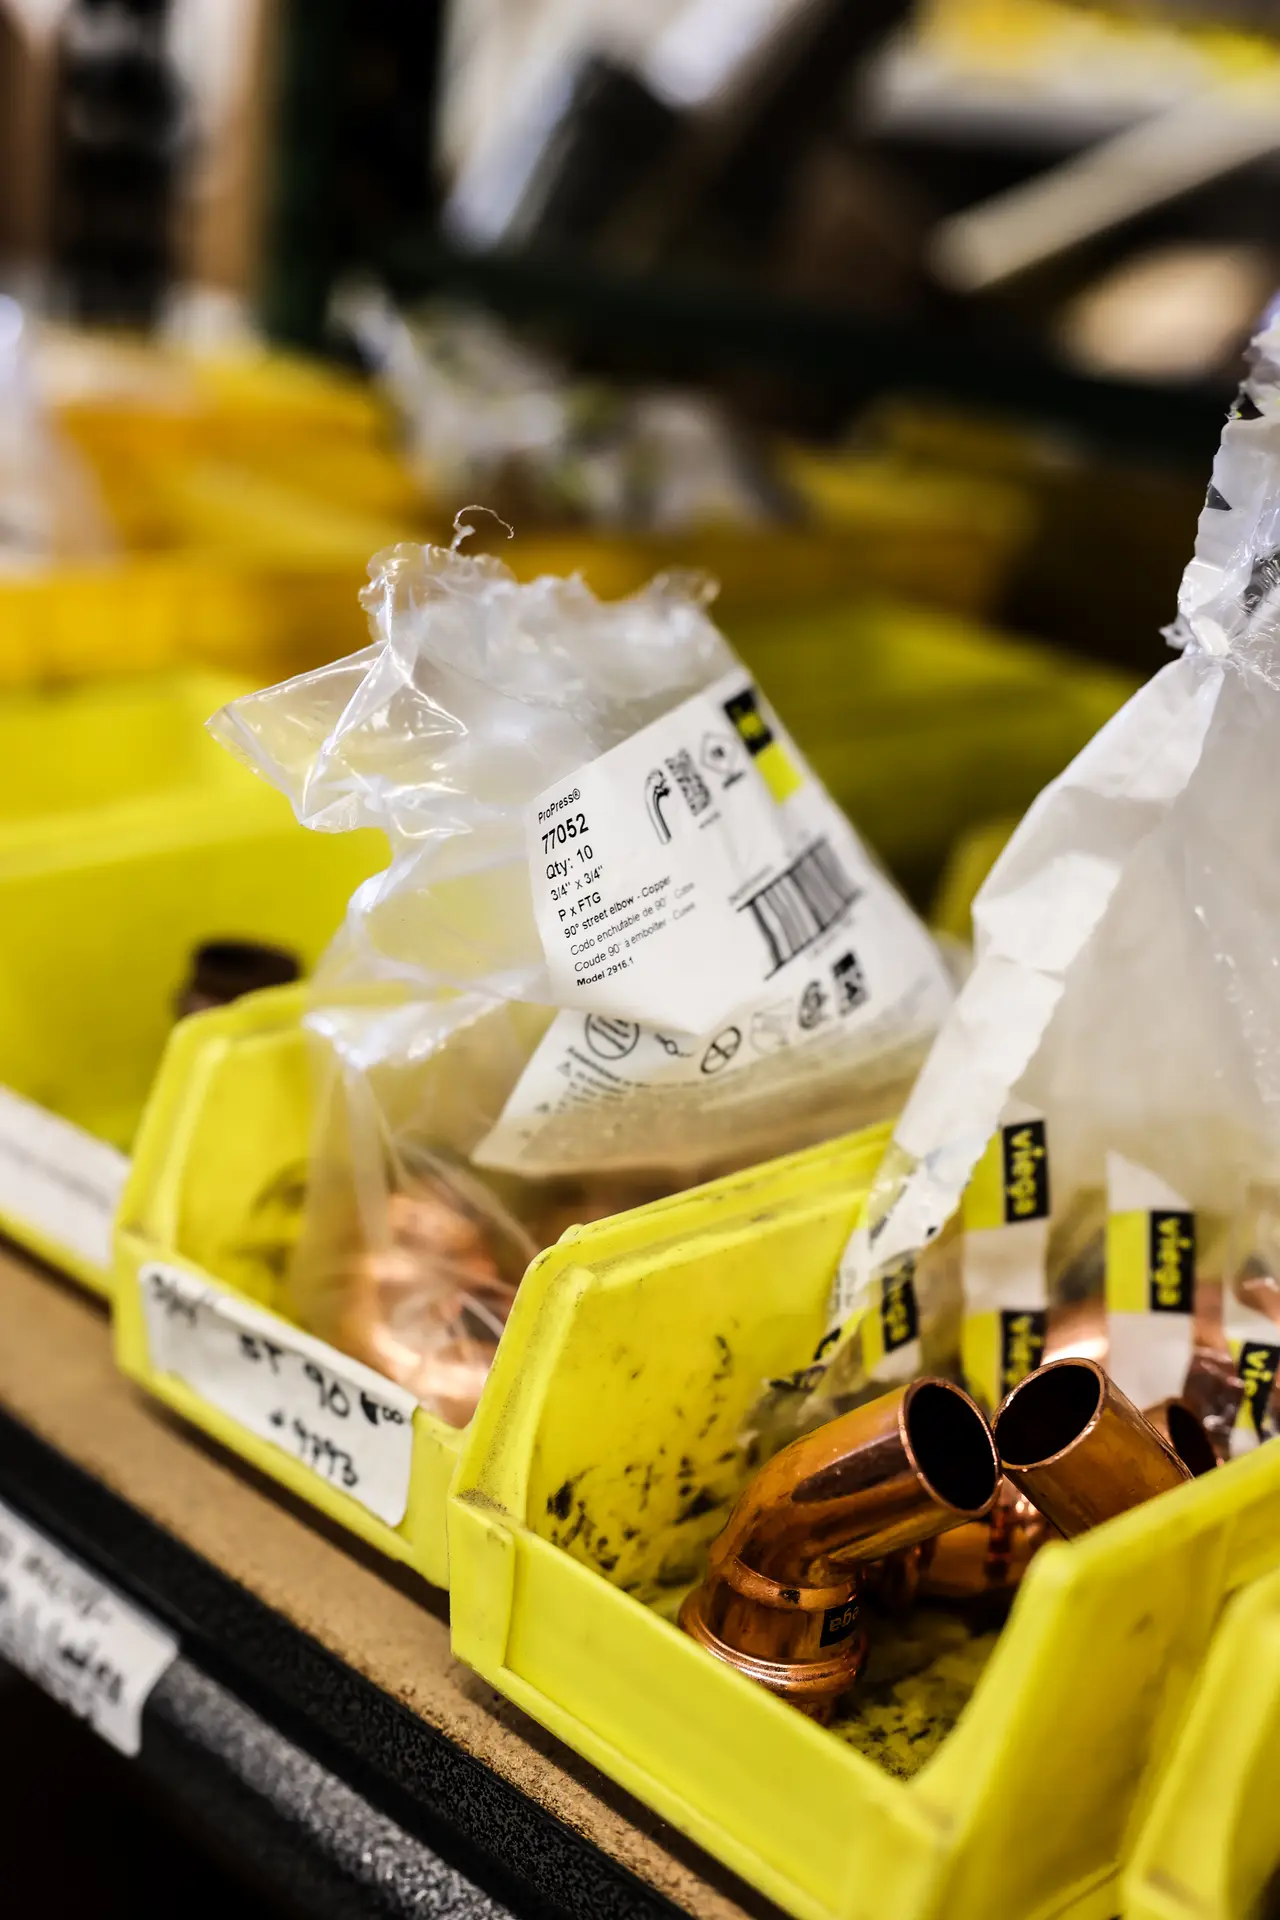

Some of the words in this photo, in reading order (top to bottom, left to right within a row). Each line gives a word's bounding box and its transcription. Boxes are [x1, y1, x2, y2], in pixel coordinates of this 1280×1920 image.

[537, 788, 582, 824] ProPress®
[541, 813, 589, 854] 77052
[546, 857, 574, 880] Qty:
[576, 844, 594, 862] 10
[551, 881, 571, 901] 3/4"
[575, 878, 583, 889] x
[583, 865, 604, 885] 3/4"
[558, 909, 567, 922] P
[570, 905, 578, 916] x
[578, 892, 602, 912] FTG
[564, 922, 580, 939] 90°
[582, 905, 612, 930] street
[610, 895, 635, 915] elbow
[641, 875, 672, 898] Copper
[570, 936, 597, 956] Codo
[642, 905, 654, 918] de
[574, 952, 607, 973] Coude
[576, 970, 606, 988] Model
[606, 956, 635, 978] 2916.1
[1006, 1128, 1046, 1214] viega
[1152, 1217, 1191, 1305] viega
[1243, 1349, 1272, 1397] vie
